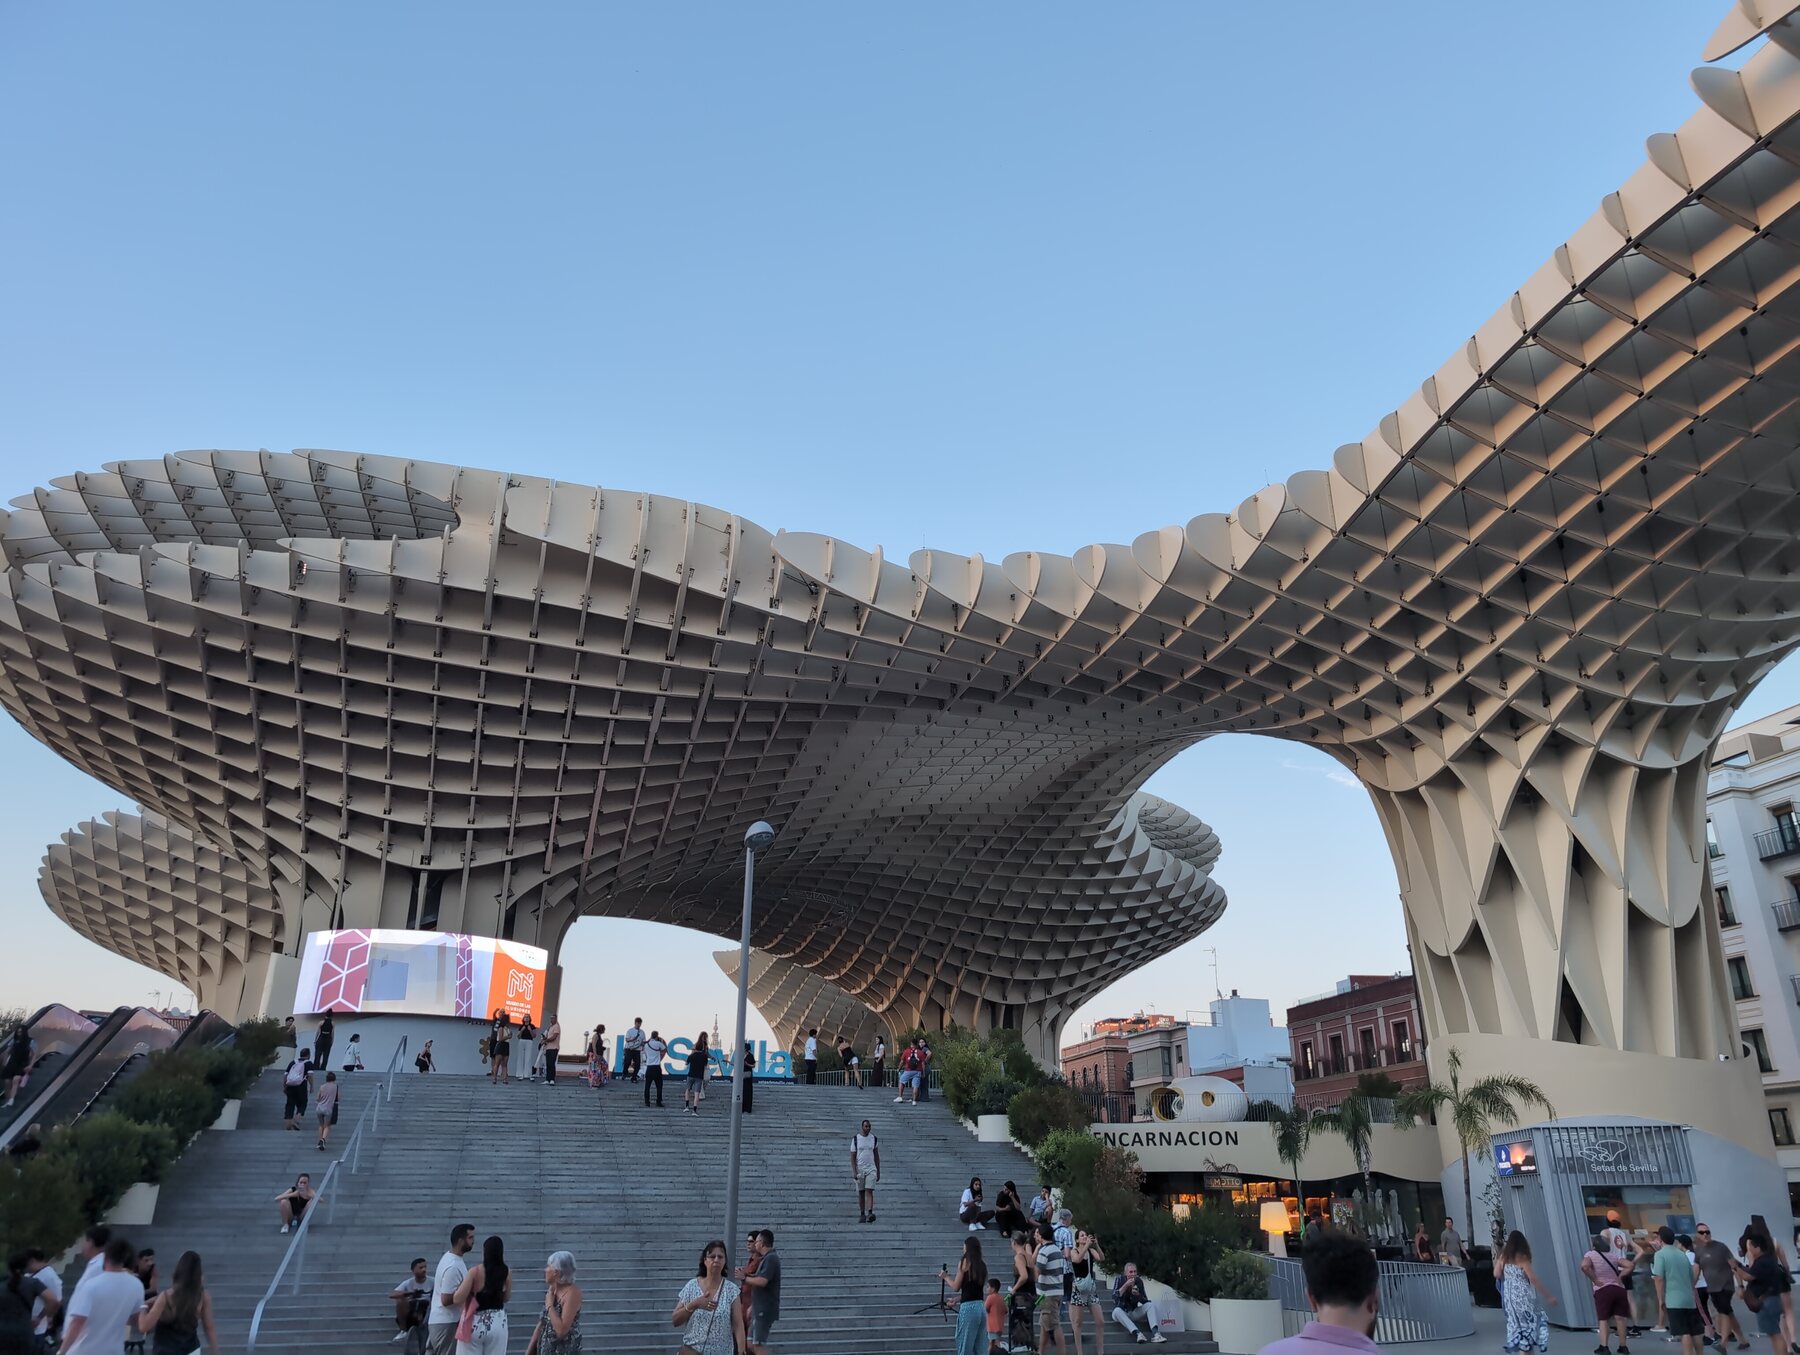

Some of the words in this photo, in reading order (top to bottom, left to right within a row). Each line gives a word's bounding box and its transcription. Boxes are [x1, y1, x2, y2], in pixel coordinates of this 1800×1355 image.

[663, 1037, 794, 1077] Svlla
[1590, 1163, 1616, 1172] Setas
[1616, 1163, 1628, 1172] de
[1629, 1163, 1658, 1172] Sevilla
